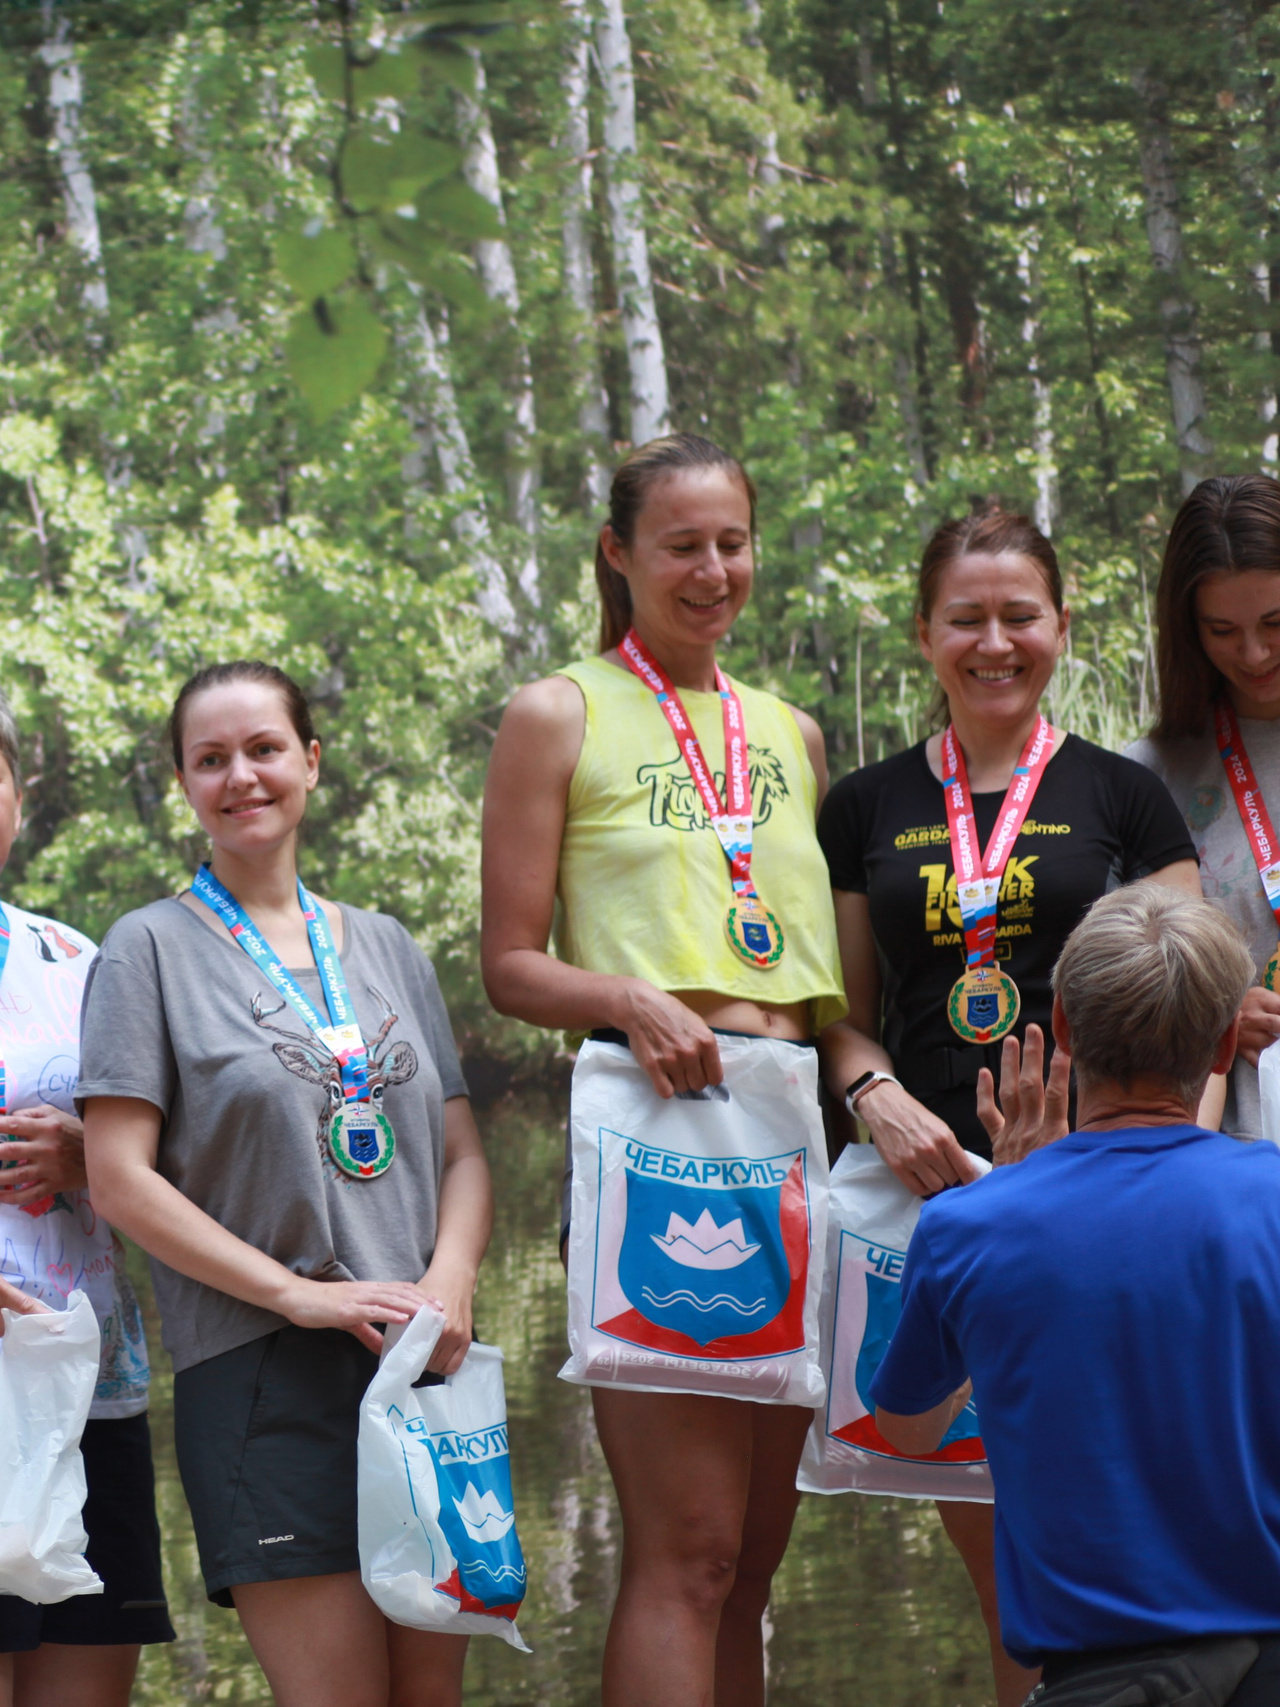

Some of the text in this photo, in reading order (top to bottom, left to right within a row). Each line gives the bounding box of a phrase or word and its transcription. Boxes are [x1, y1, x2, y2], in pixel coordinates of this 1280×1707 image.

[666, 700, 687, 731] 2024
[987, 807, 1019, 872] ЧЕБАРКУЛЬ
[1013, 776, 1032, 803] 2024
[1231, 754, 1272, 862] ЧЕБАРКУЛЬ 2024
[894, 828, 951, 848] GARDA
[952, 782, 974, 879] ЧЕБАРКУЛЬ 2024
[933, 923, 1032, 947] RIVA ARDA
[241, 929, 318, 1025] ЧЕБАРКУЛЬ 2024
[312, 922, 347, 1020] ЧЕБАРКУЛЬ 2024
[625, 1142, 788, 1186] ЧЕБАРКУЛЬ
[620, 1351, 753, 1379] ЭСТАФЕТЫ 2024
[258, 1534, 294, 1545] HEAD
